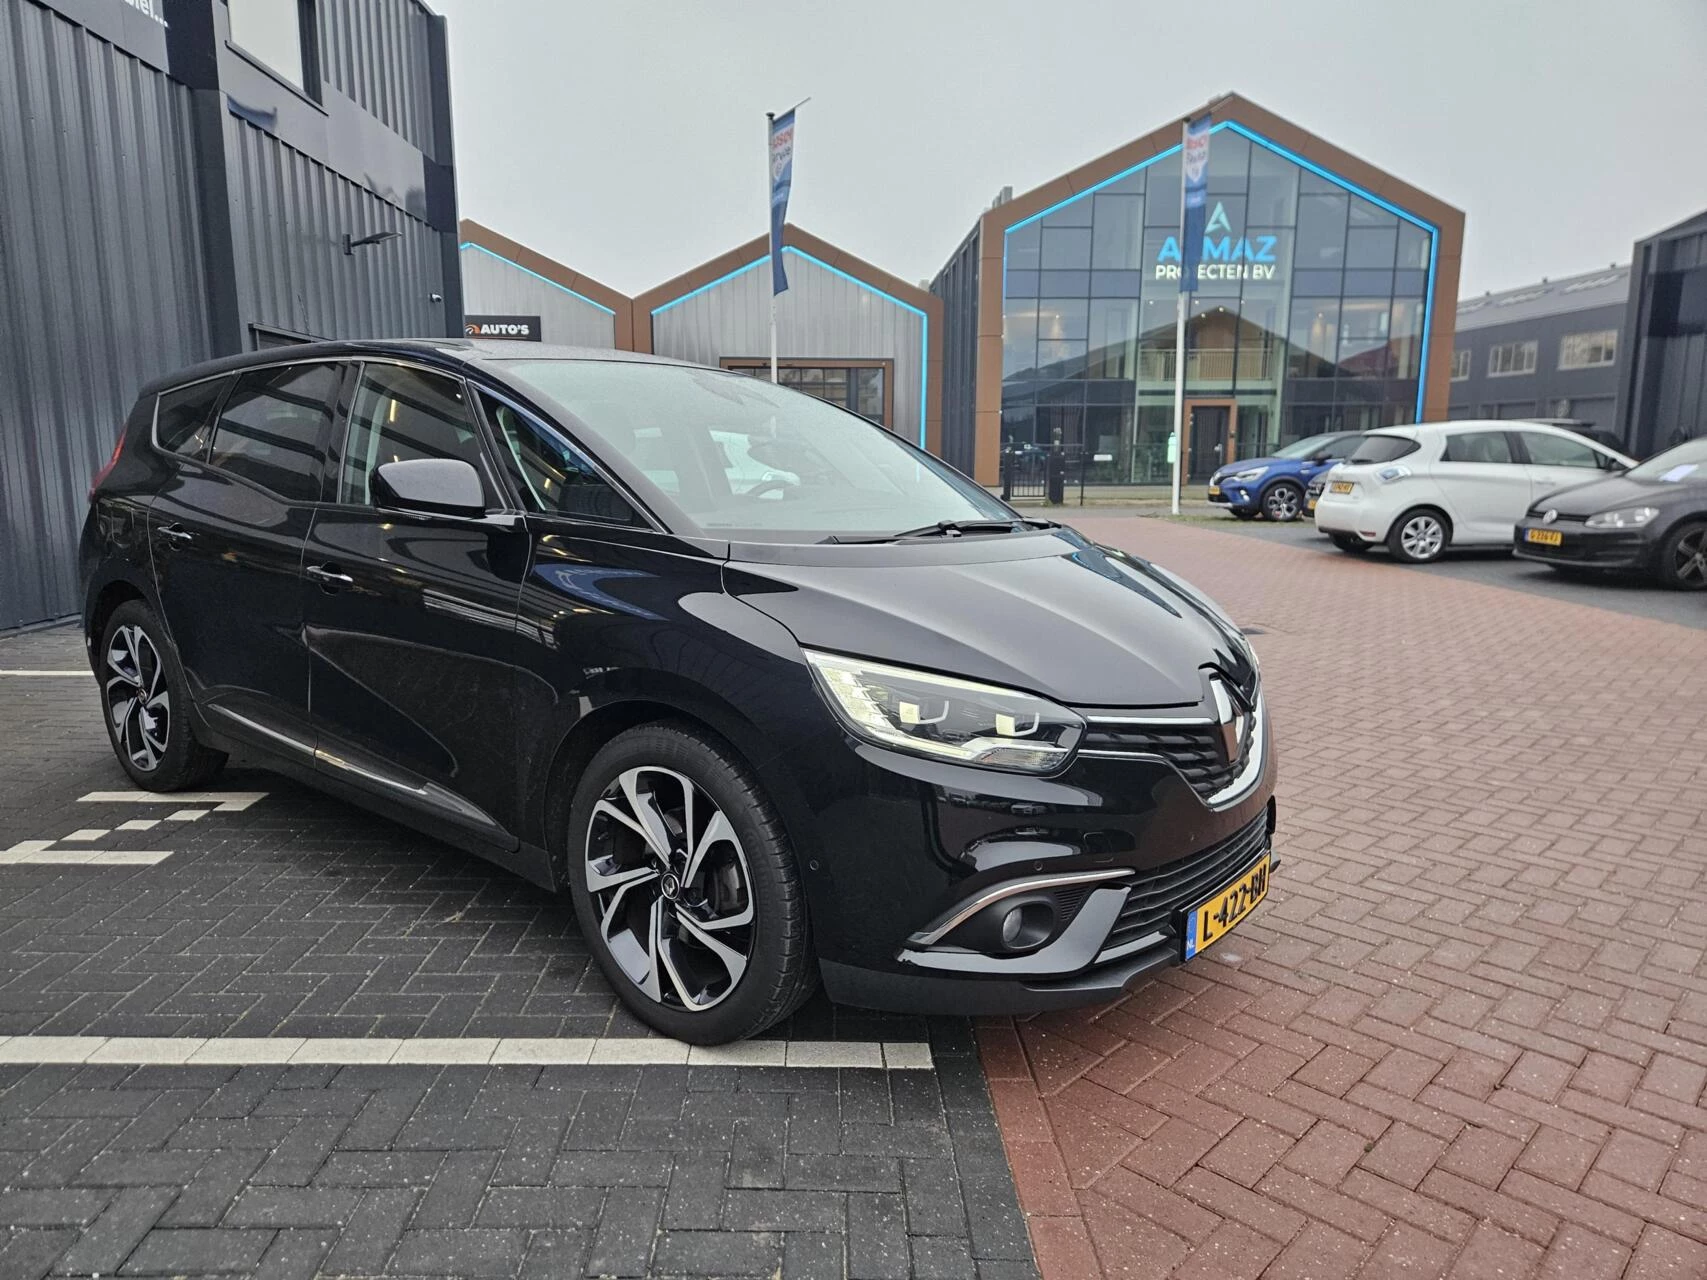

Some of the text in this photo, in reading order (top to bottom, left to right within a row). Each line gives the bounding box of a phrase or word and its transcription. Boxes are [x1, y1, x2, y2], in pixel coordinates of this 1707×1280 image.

[1157, 235, 1278, 262] AMAZ
[1155, 264, 1276, 280] PRECTEN BV
[480, 324, 530, 335] AUTO'S
